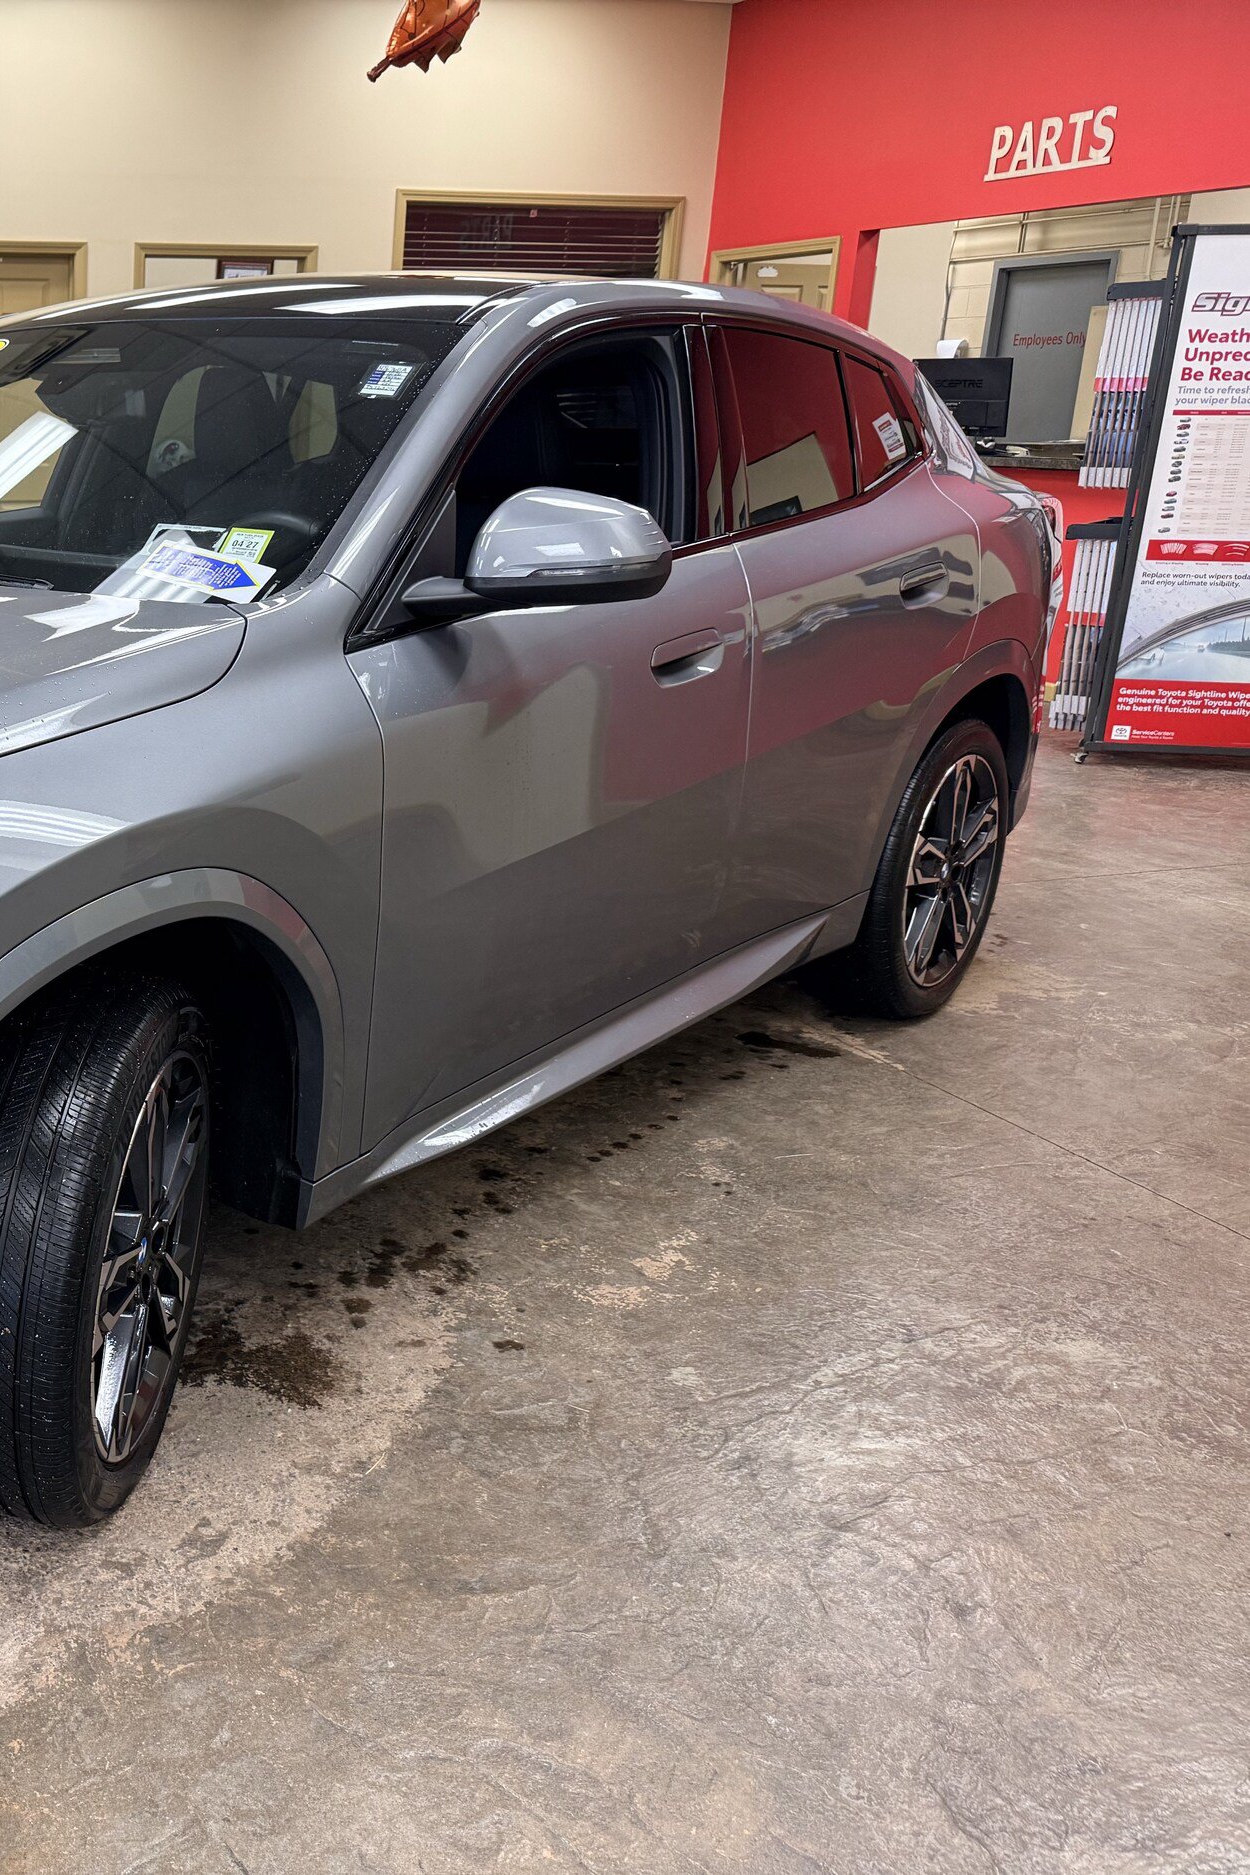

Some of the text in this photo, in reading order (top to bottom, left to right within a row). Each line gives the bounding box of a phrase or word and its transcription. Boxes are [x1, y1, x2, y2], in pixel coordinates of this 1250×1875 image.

[984, 105, 1118, 181] PARTS
[1013, 331, 1086, 350] Employees Only
[1181, 367, 1204, 381] Be
[934, 379, 984, 388] SCEPTRE
[1178, 386, 1201, 394] Time
[1204, 386, 1215, 394] to
[1175, 397, 1198, 406] your
[1200, 396, 1229, 406] wiper
[1156, 579, 1175, 587] enjoy
[1209, 580, 1241, 588] visibility.
[1119, 687, 1156, 696] Genuine
[1157, 688, 1185, 698] Toyota
[1187, 689, 1227, 699] Sightline
[1117, 696, 1166, 706] engineered
[1167, 697, 1181, 705] for
[1181, 699, 1202, 707] your
[1204, 699, 1232, 709] Toyota
[1132, 704, 1151, 712] best
[1164, 705, 1201, 714] function
